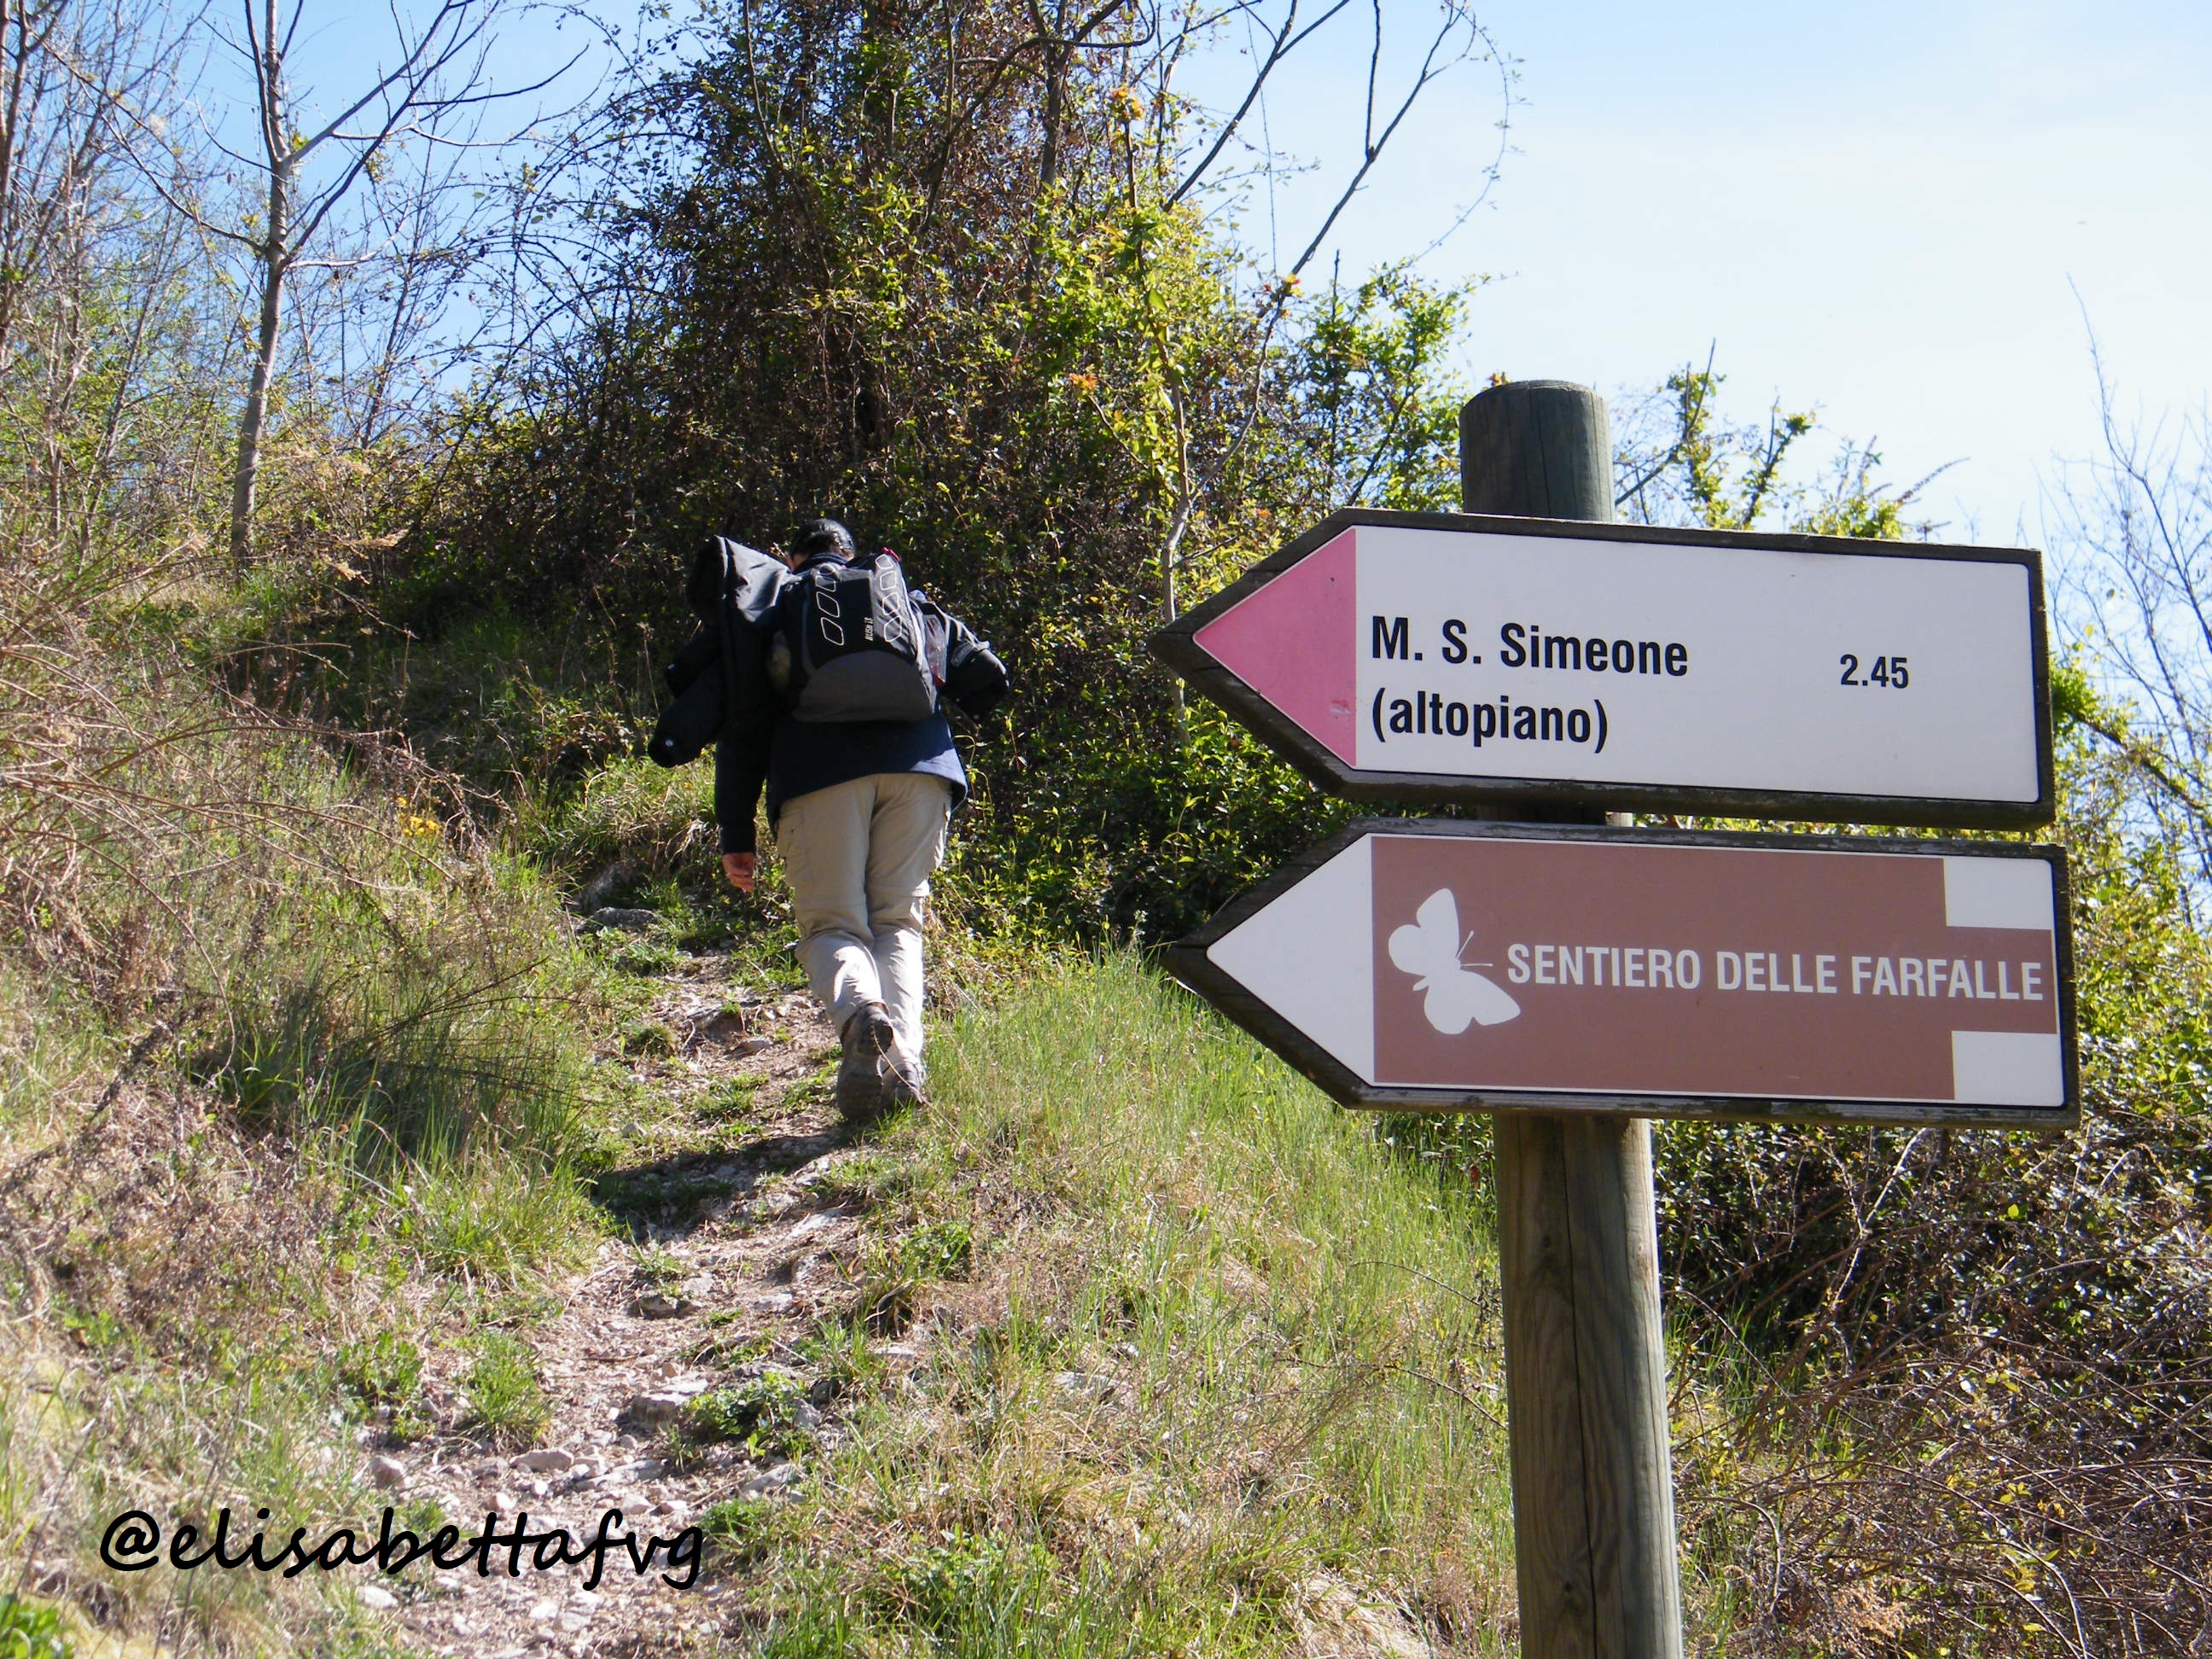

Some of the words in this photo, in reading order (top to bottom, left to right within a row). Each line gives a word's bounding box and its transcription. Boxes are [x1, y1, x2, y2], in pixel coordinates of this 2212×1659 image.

[1372, 615, 1423, 661] M.
[1441, 619, 1481, 668] S.
[1499, 622, 1688, 677] Simeone
[1839, 654, 1909, 690] 2.45
[1372, 687, 1608, 754] (altopiano)
[1507, 943, 1701, 990] SENTIERO
[1716, 951, 1837, 994] DELLE
[1851, 956, 2044, 1001] FARFALLE
